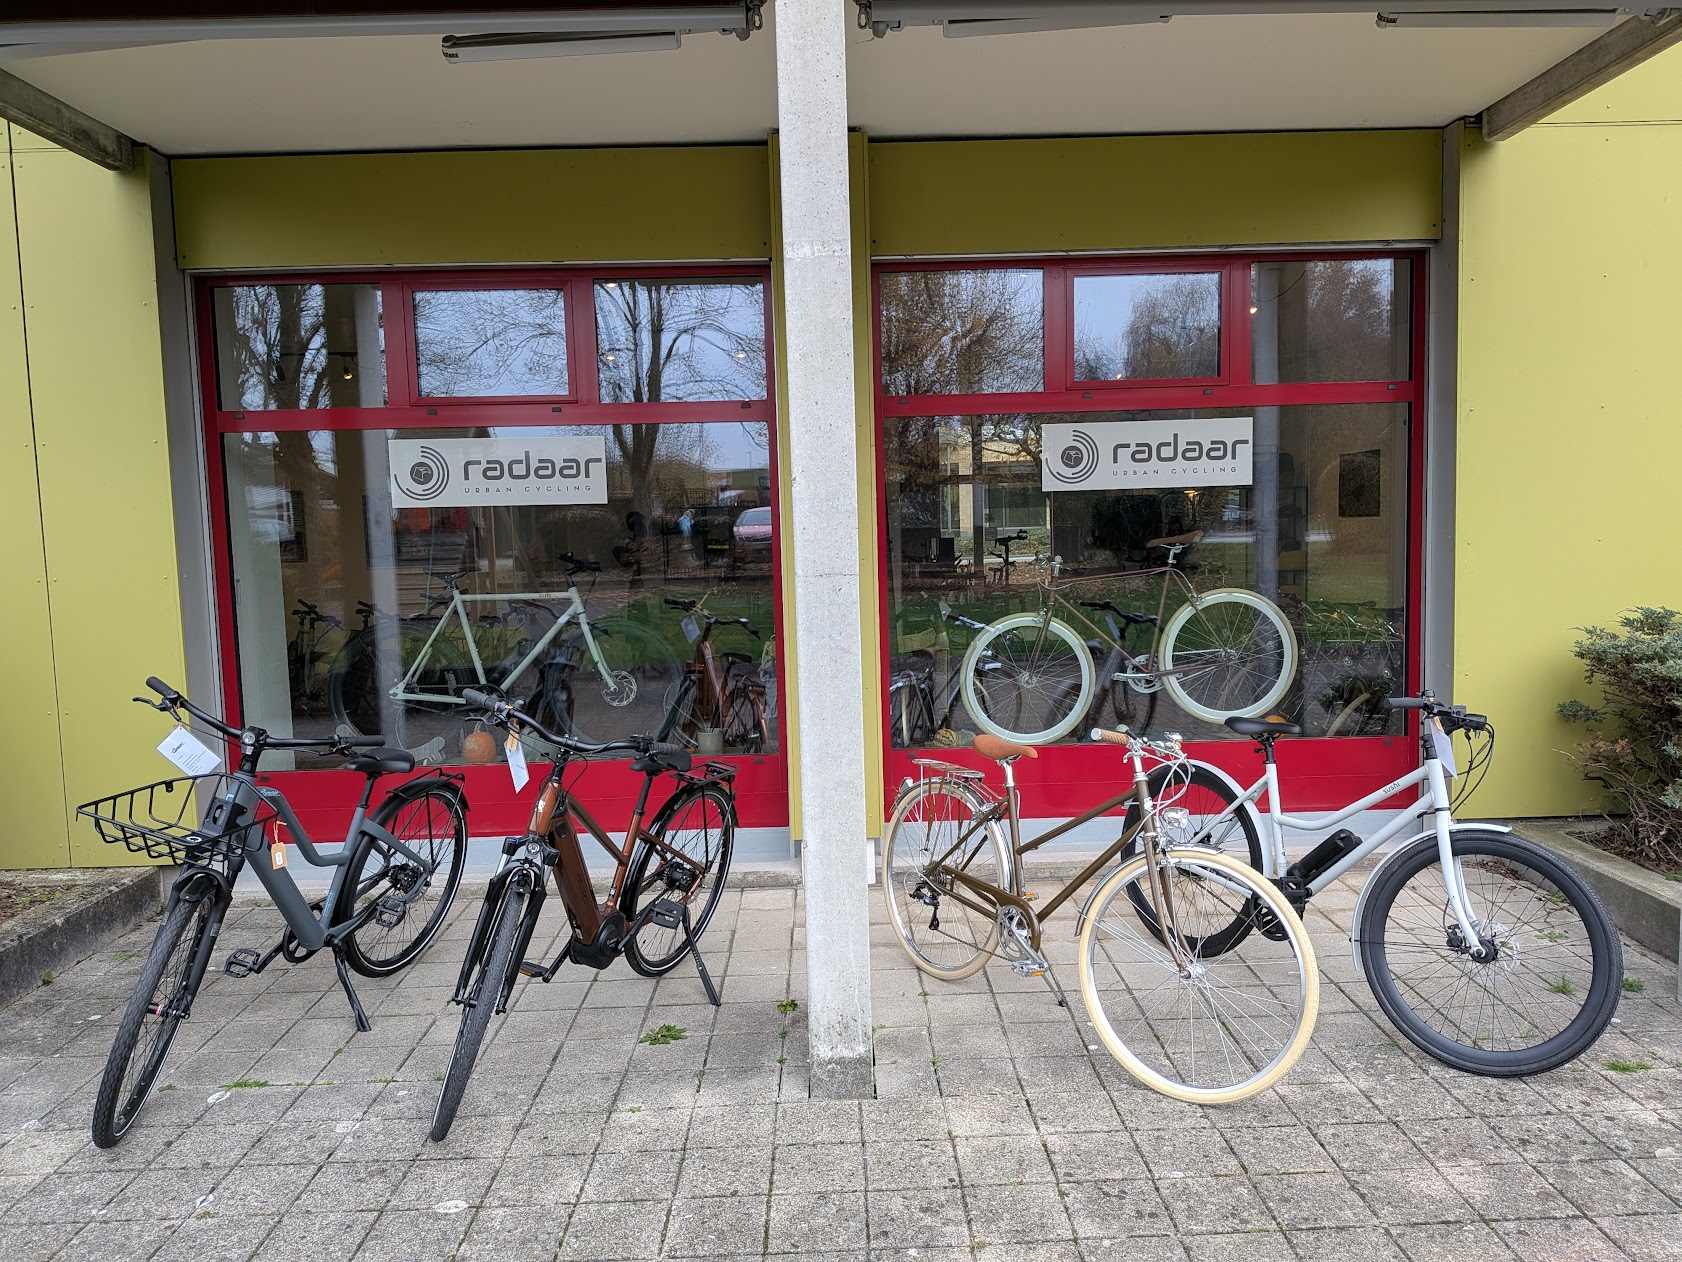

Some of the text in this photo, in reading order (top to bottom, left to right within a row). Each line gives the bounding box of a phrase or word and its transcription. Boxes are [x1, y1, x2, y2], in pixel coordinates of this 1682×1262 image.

[1112, 433, 1250, 464] radaar
[463, 450, 602, 481] radaar
[1382, 782, 1401, 795] sushi
